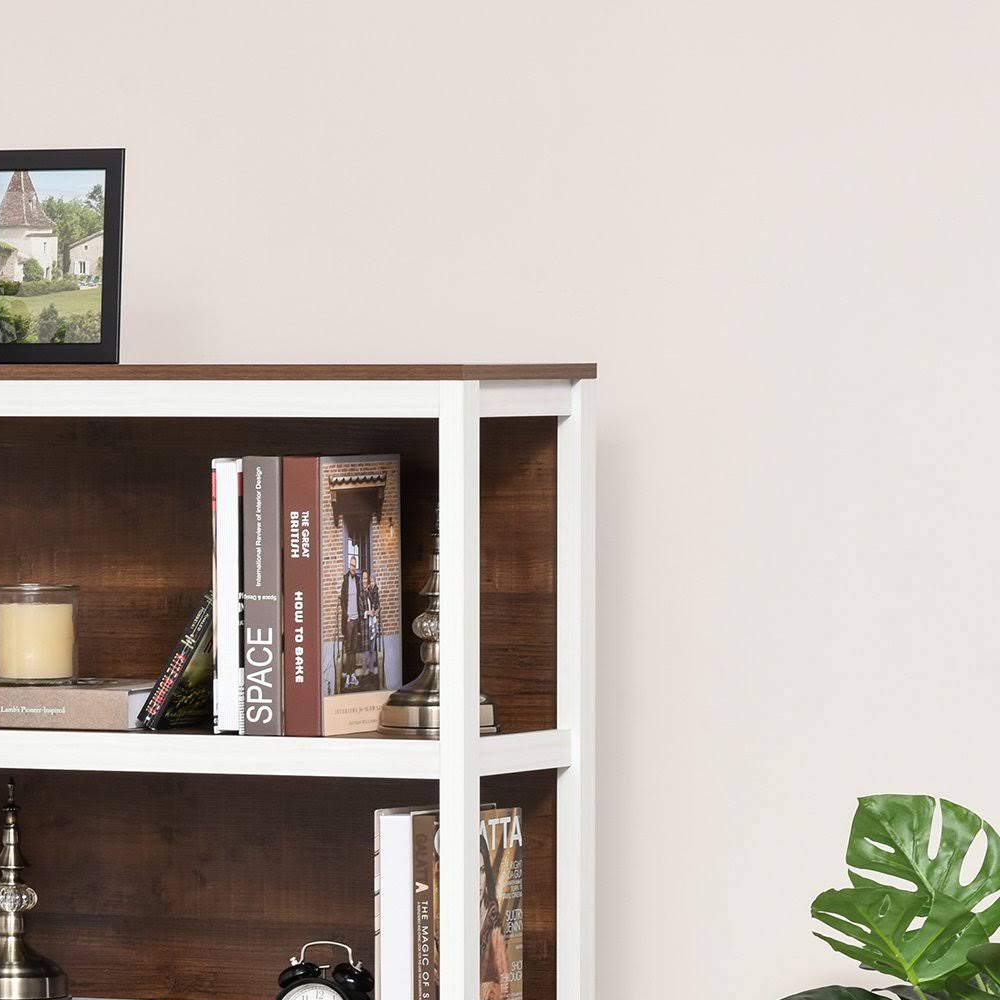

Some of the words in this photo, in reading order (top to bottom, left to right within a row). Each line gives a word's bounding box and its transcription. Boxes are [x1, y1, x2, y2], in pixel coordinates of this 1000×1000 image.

[255, 466, 264, 489] Design
[301, 511, 310, 526] THE
[255, 522, 263, 546] Review
[290, 511, 300, 558] BRITISH
[301, 529, 310, 558] GREAT
[255, 547, 263, 587] International
[294, 591, 304, 623] HOW
[294, 627, 304, 643] TO
[166, 652, 187, 678] KITE
[246, 627, 273, 724] SPACE
[294, 647, 304, 683] BAKE
[421, 901, 429, 920] THE
[422, 971, 430, 987] OF
[315, 990, 325, 1000] 12
